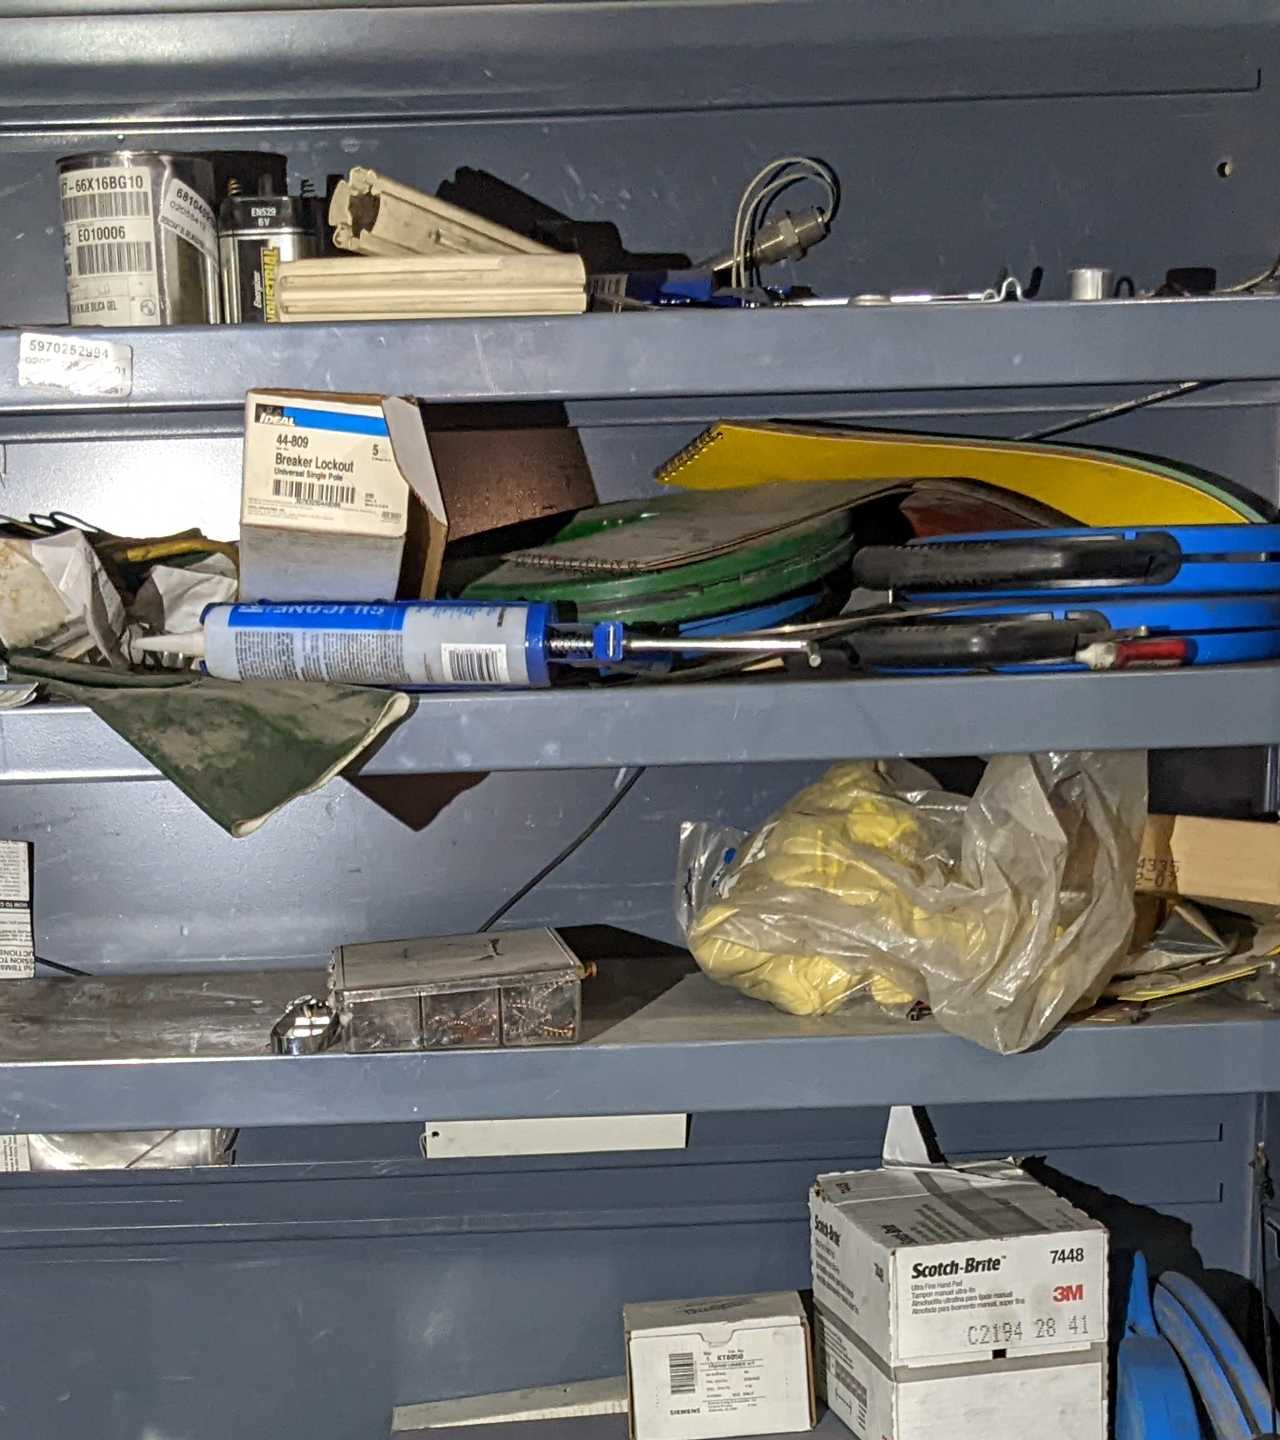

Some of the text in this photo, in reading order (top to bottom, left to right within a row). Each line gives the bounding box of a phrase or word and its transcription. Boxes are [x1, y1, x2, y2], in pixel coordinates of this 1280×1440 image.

[259, 411, 296, 427] IDEAL
[276, 433, 380, 456] 44-809 5
[275, 452, 355, 474] Breaker Lockout
[274, 467, 343, 482] Universal Single Pole
[1050, 1247, 1085, 1265] 7448
[937, 1280, 951, 1289] Hand
[951, 1279, 963, 1288] Pad
[1052, 1284, 1084, 1304] 3M
[968, 1314, 1090, 1346] C2194 28 41
